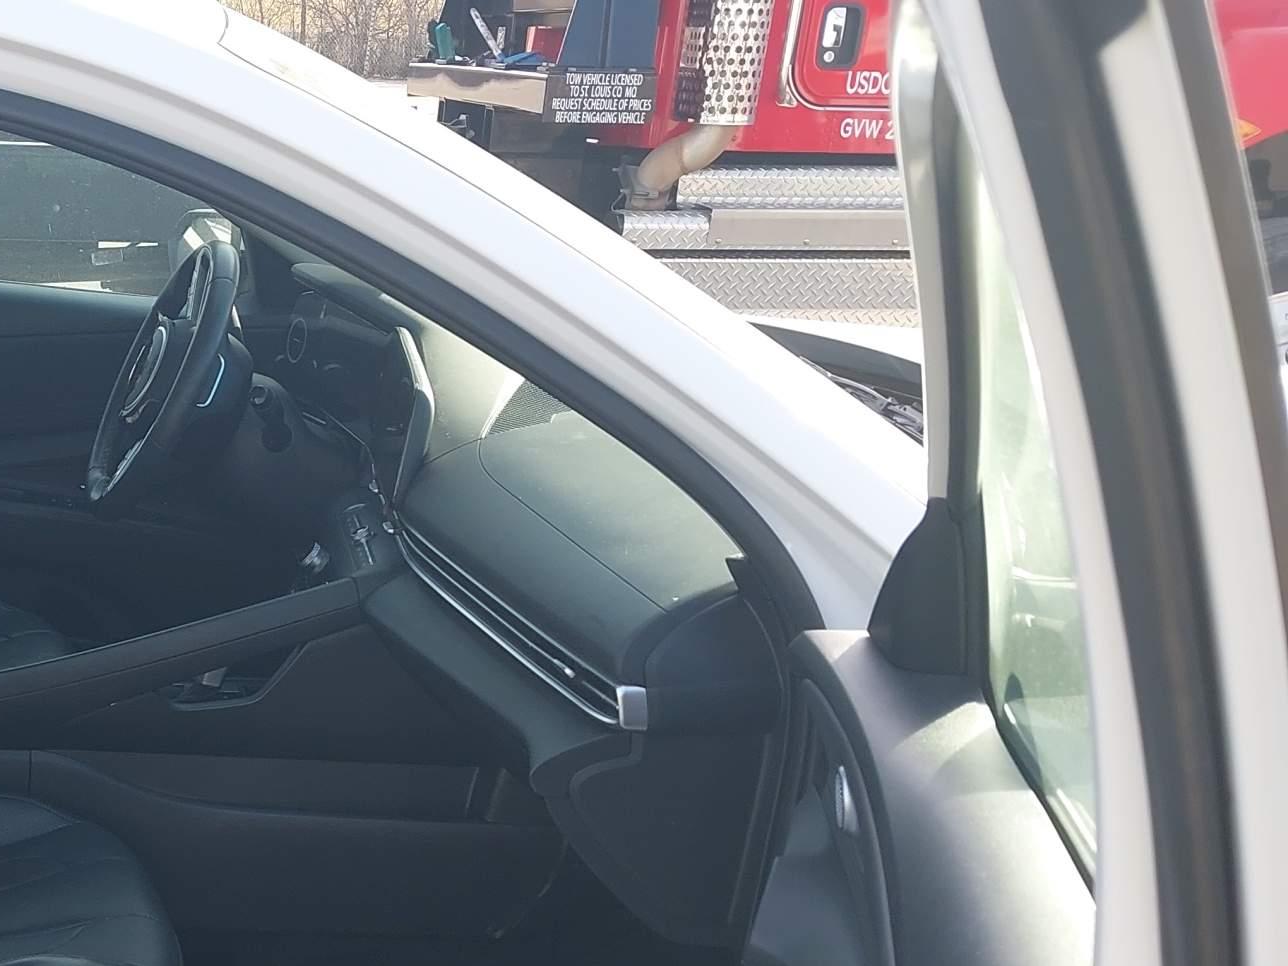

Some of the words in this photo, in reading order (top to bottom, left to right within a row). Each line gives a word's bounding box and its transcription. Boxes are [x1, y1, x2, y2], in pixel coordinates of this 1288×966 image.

[566, 73, 581, 85] TOW
[582, 73, 610, 86] VEHICLE
[611, 74, 643, 86] LICENSED
[846, 71, 890, 95] USDO
[570, 86, 580, 97] TO
[591, 86, 612, 98] LOUIS
[552, 98, 582, 110] REQUEST
[582, 98, 618, 111] SCHEDULE
[618, 99, 629, 111] OF
[629, 99, 652, 111] PRICES
[555, 111, 581, 123] BEFORE
[581, 111, 617, 124] ENGAGING
[617, 112, 646, 124] VEHICLE
[840, 118, 883, 139] GVW
[885, 120, 896, 140] 2
